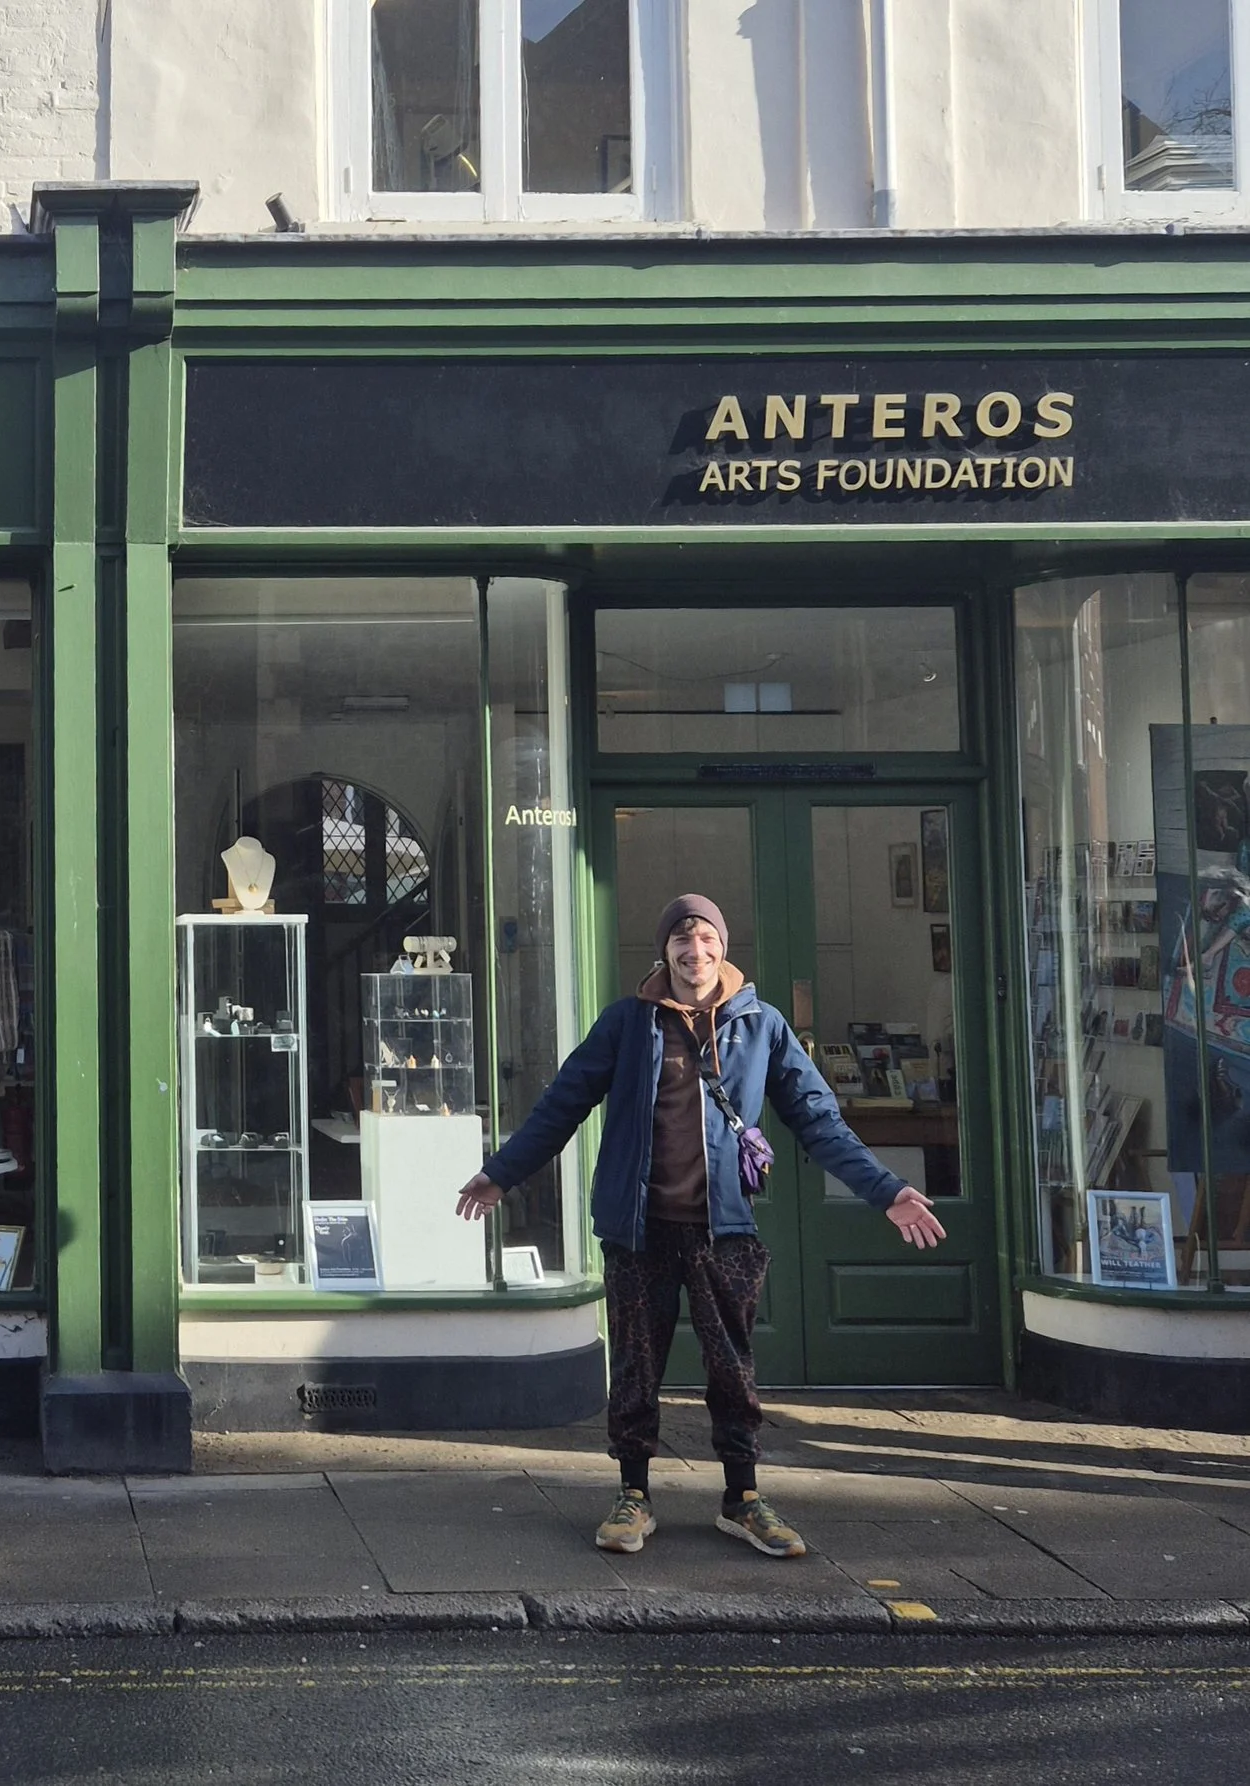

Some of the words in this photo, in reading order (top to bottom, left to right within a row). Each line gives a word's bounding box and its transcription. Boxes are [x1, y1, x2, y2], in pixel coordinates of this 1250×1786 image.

[704, 391, 1074, 440] ANTEROS
[698, 459, 801, 492] ARTS
[816, 456, 1074, 491] FOUNDATION
[505, 805, 571, 827] Anteros
[1101, 1259, 1122, 1267] WILL
[1123, 1260, 1161, 1269] TEATHER
